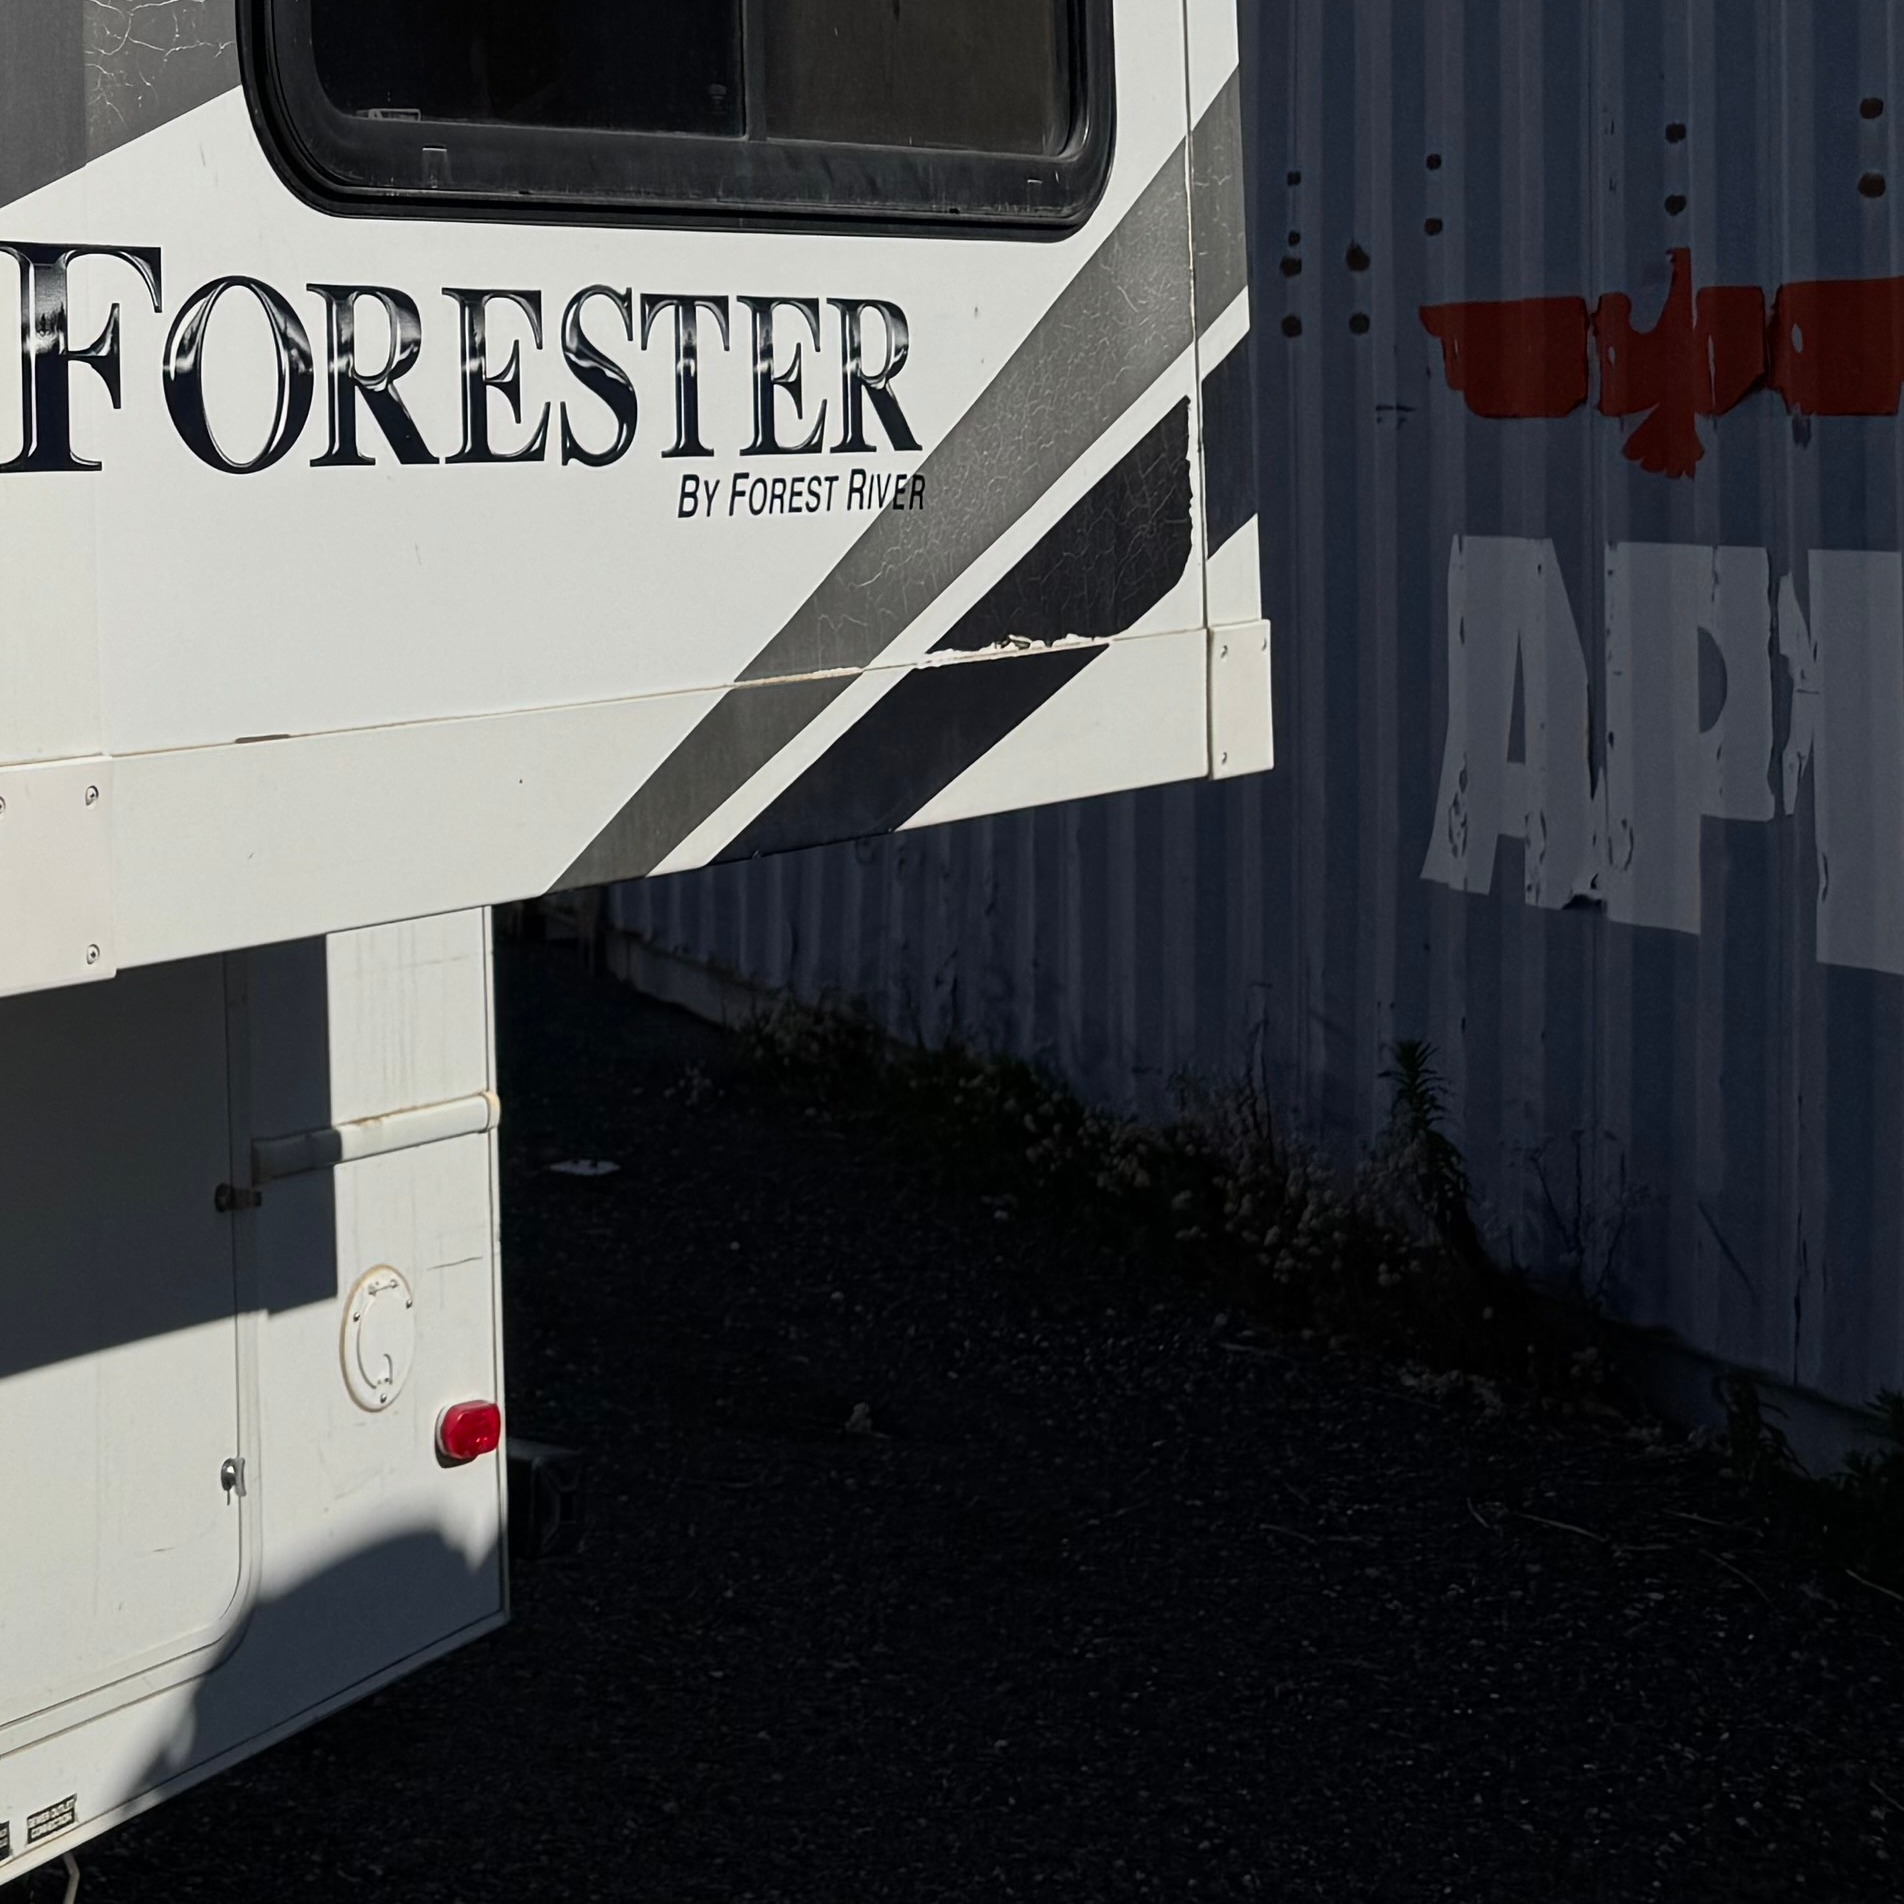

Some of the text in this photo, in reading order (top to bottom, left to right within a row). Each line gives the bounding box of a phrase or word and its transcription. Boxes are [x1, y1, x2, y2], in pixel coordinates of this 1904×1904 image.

[677, 467, 928, 520] BY FOREST RIVER
